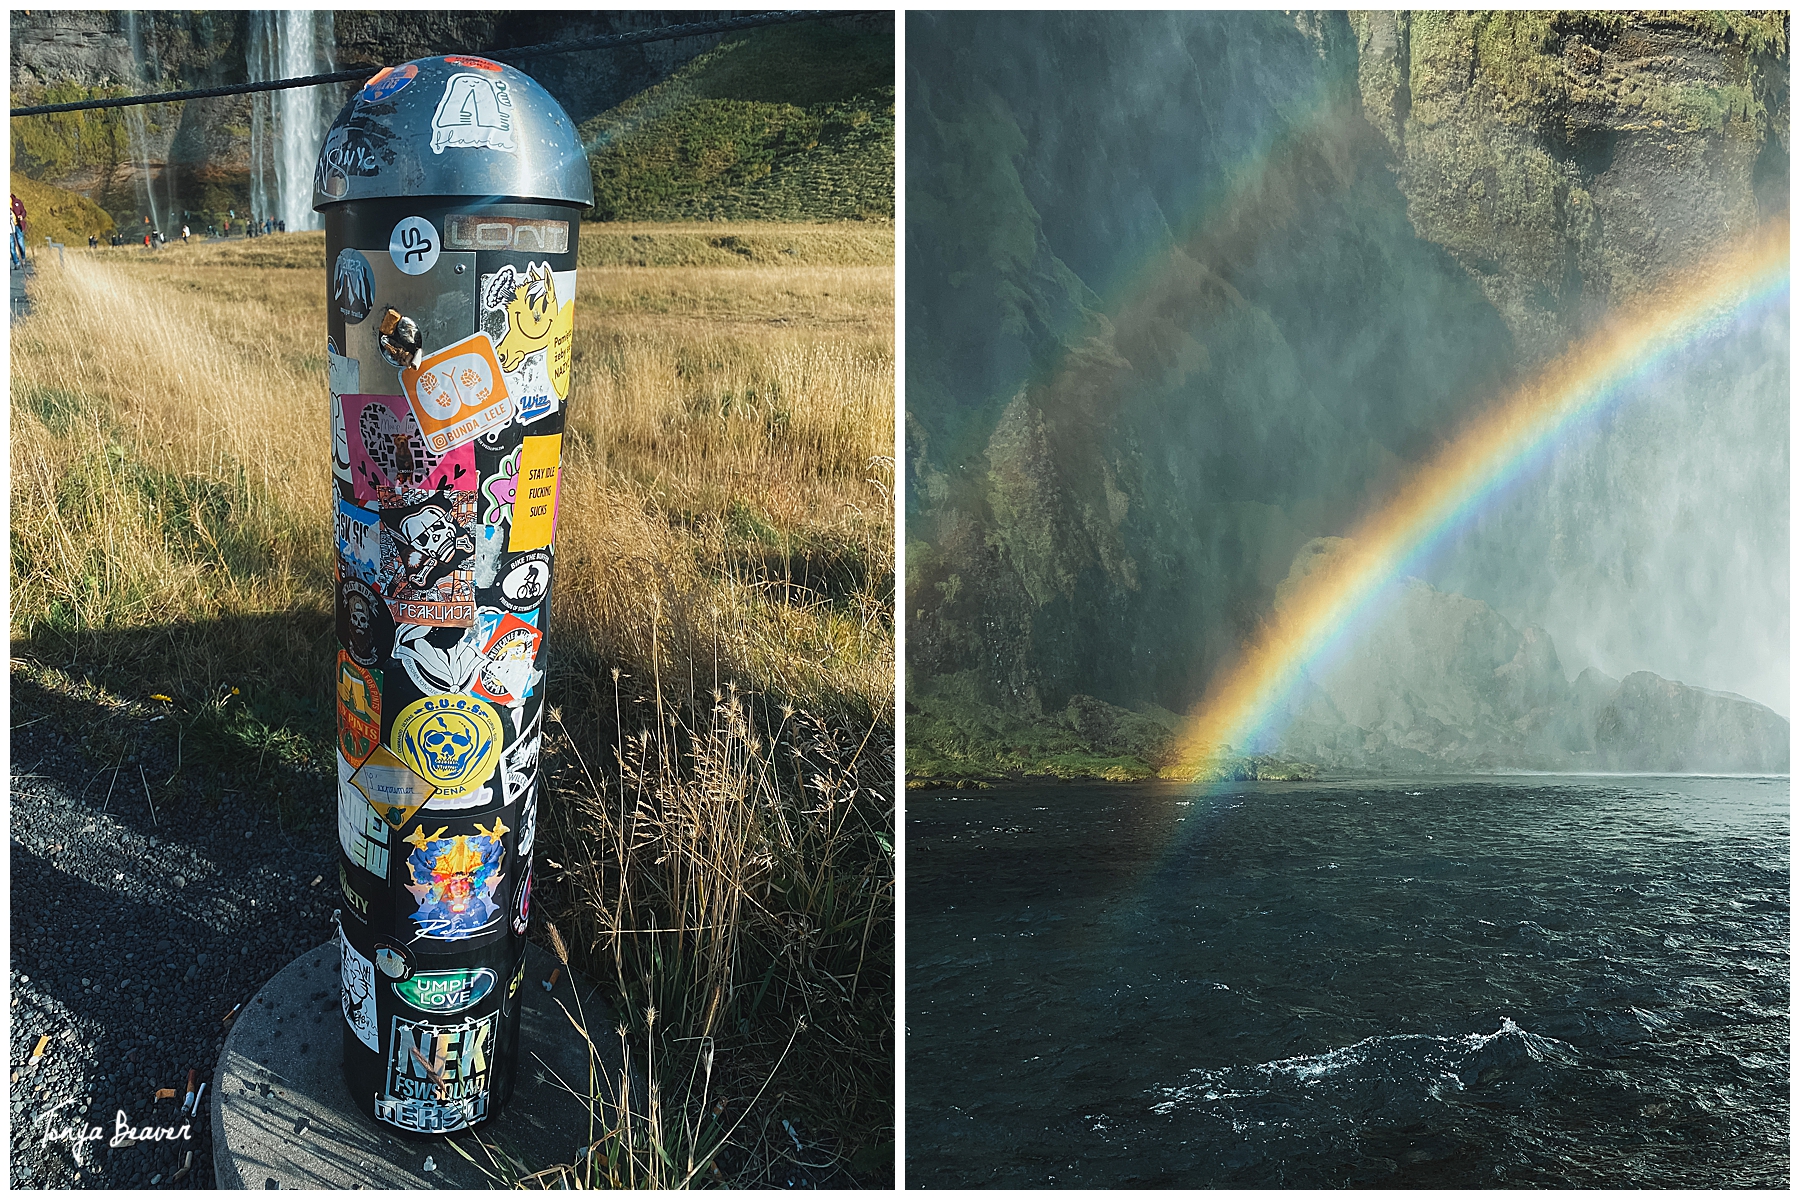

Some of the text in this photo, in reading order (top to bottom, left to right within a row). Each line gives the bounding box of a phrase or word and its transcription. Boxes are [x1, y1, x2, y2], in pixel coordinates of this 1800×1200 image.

[520, 393, 550, 411] Wizz
[529, 468, 545, 480] STAY
[529, 486, 552, 499] FUCKING
[529, 504, 548, 517] SUCKS
[510, 556, 526, 569] BIKE
[526, 553, 536, 562] THE
[365, 674, 376, 692] FOR
[348, 712, 378, 740] PINTS
[417, 976, 475, 992] UMPH
[420, 990, 471, 1006] LOVE
[398, 1023, 490, 1080] NEK
